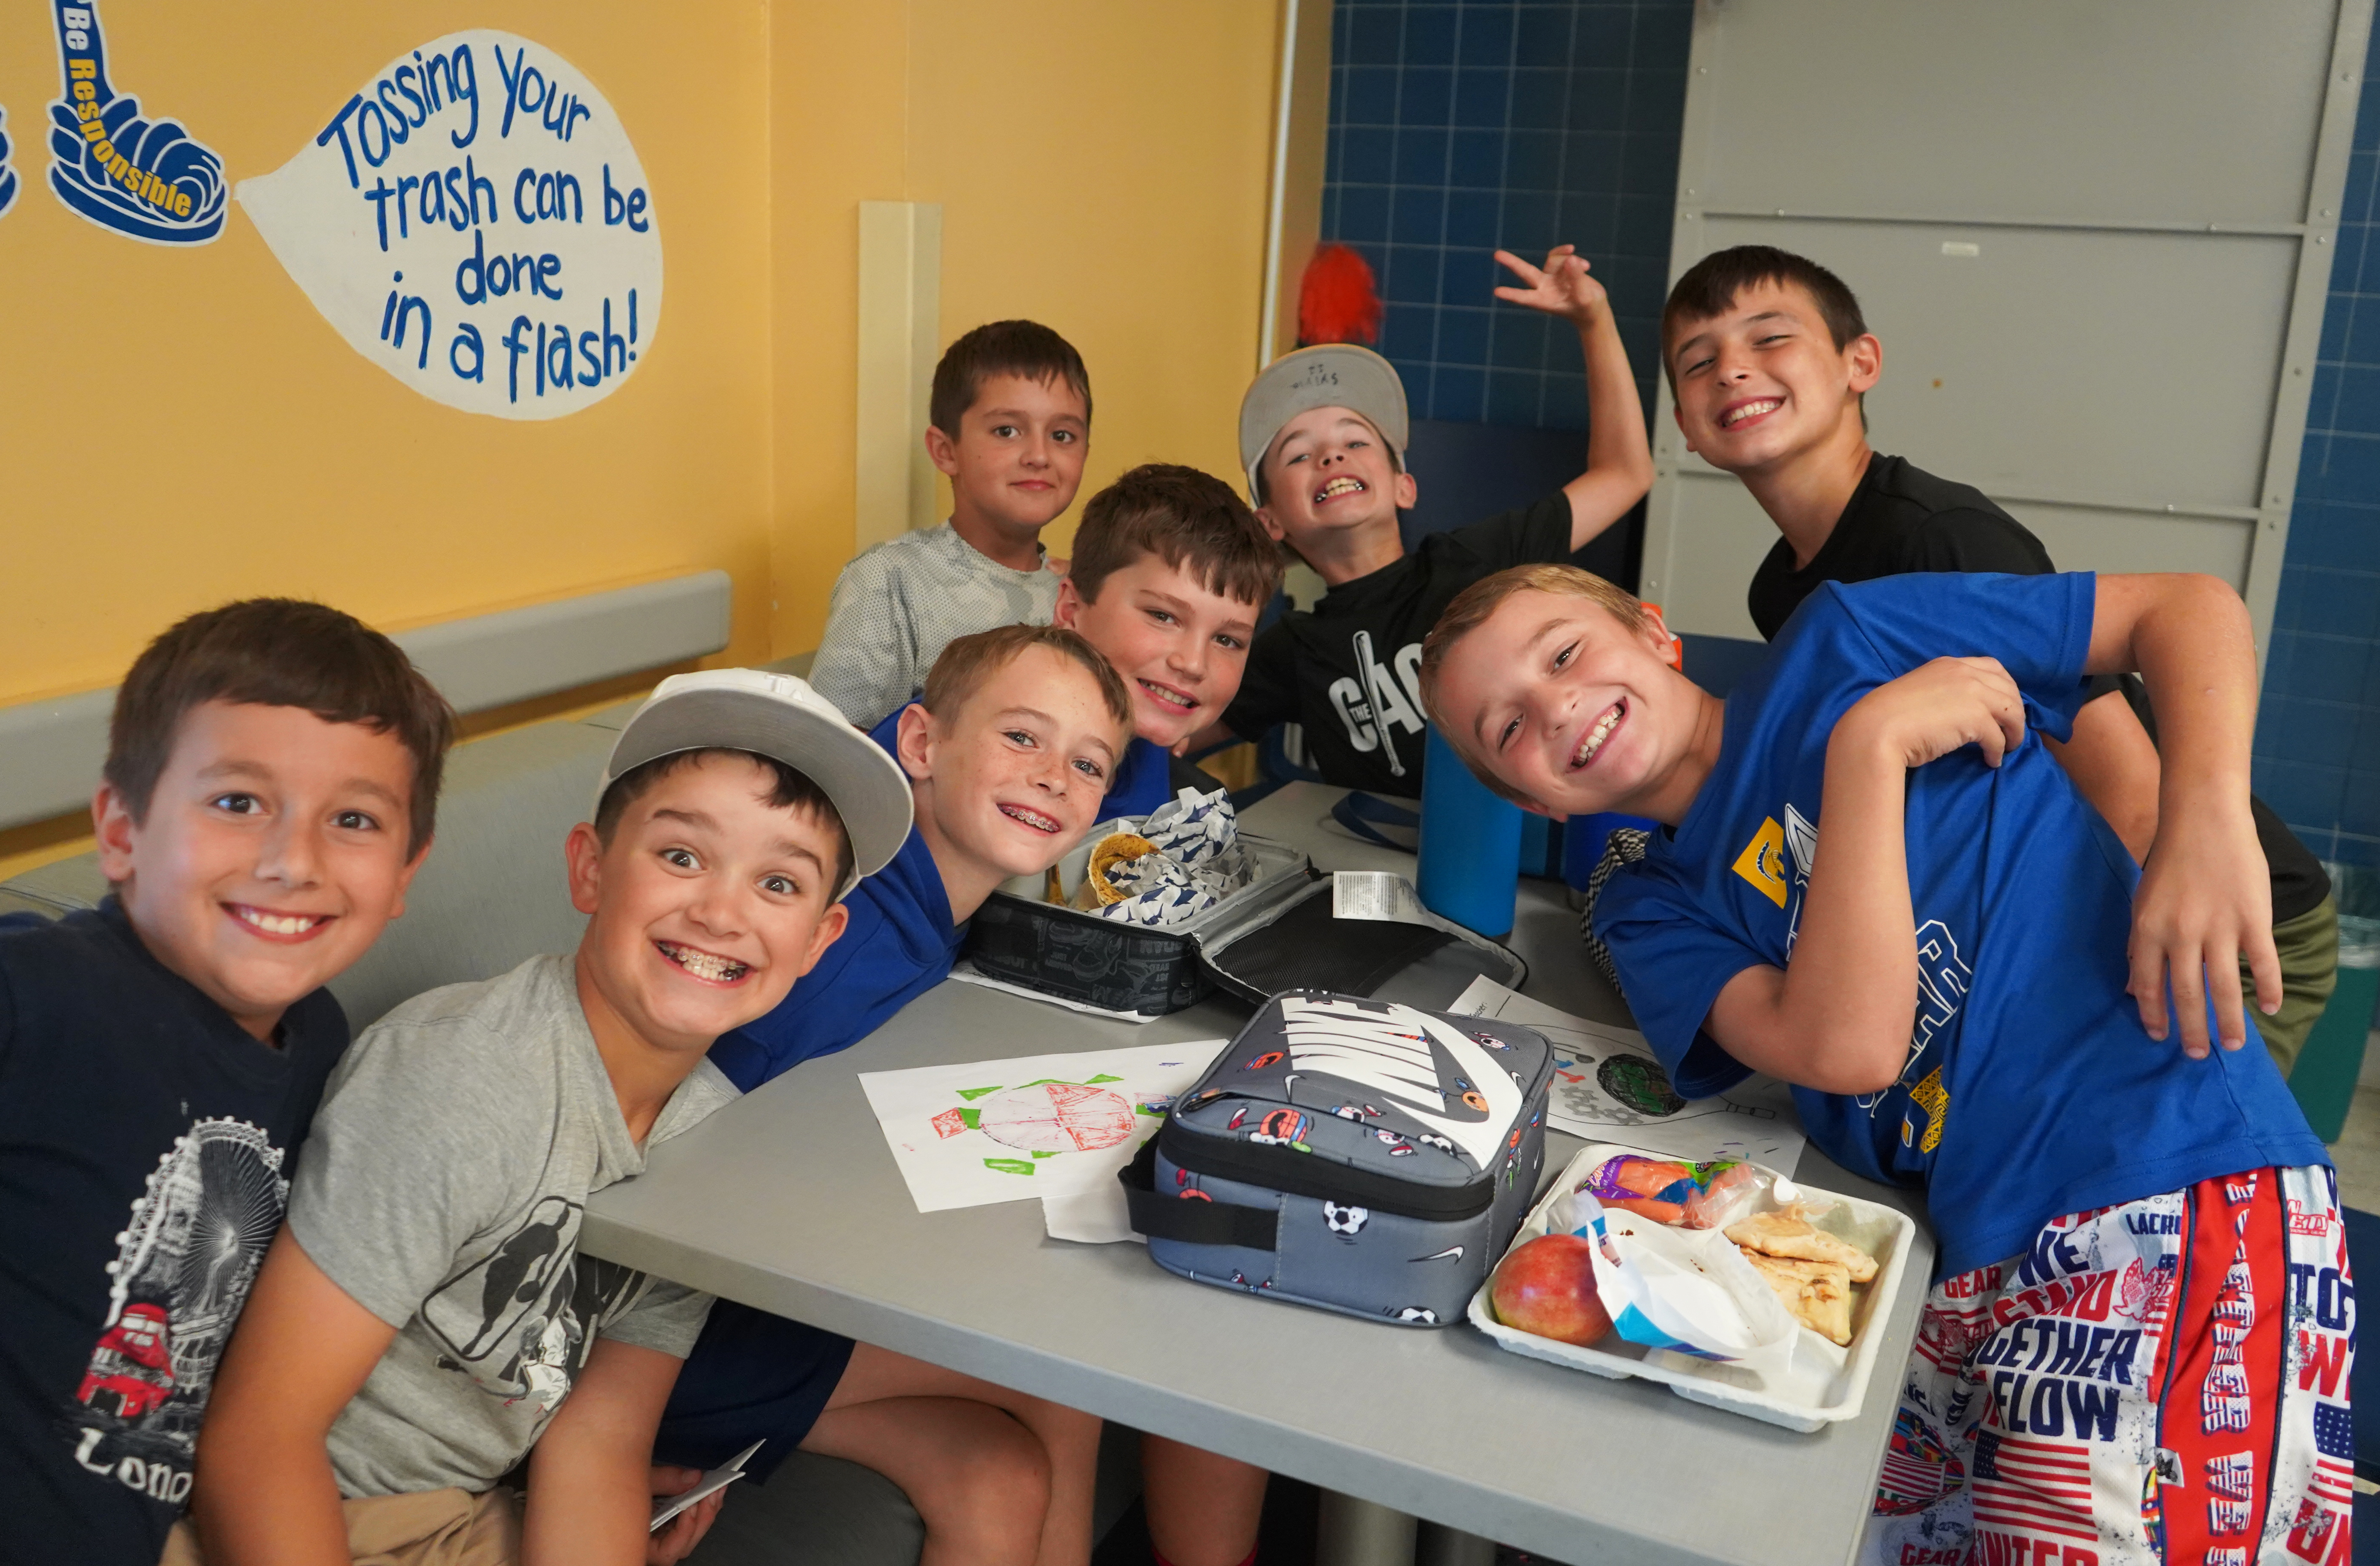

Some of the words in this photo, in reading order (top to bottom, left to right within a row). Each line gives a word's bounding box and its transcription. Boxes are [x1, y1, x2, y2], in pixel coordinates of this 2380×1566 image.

[63, 6, 90, 50] Be
[69, 59, 192, 217] Responsible
[317, 44, 479, 188] Tossing
[364, 154, 498, 252] trash
[515, 168, 582, 224] can
[603, 163, 649, 233] be
[456, 229, 563, 306] done
[380, 270, 432, 369] in
[450, 322, 484, 384] a
[502, 288, 638, 405] flash!
[1349, 703, 1373, 722] THE
[1944, 1266, 2001, 1298] GEAR
[1963, 1319, 2142, 1385] GETHER
[1994, 1370, 2120, 1442] FLOW
[2204, 1450, 2253, 1537] WE
[1900, 1543, 1961, 1566] GEAR
